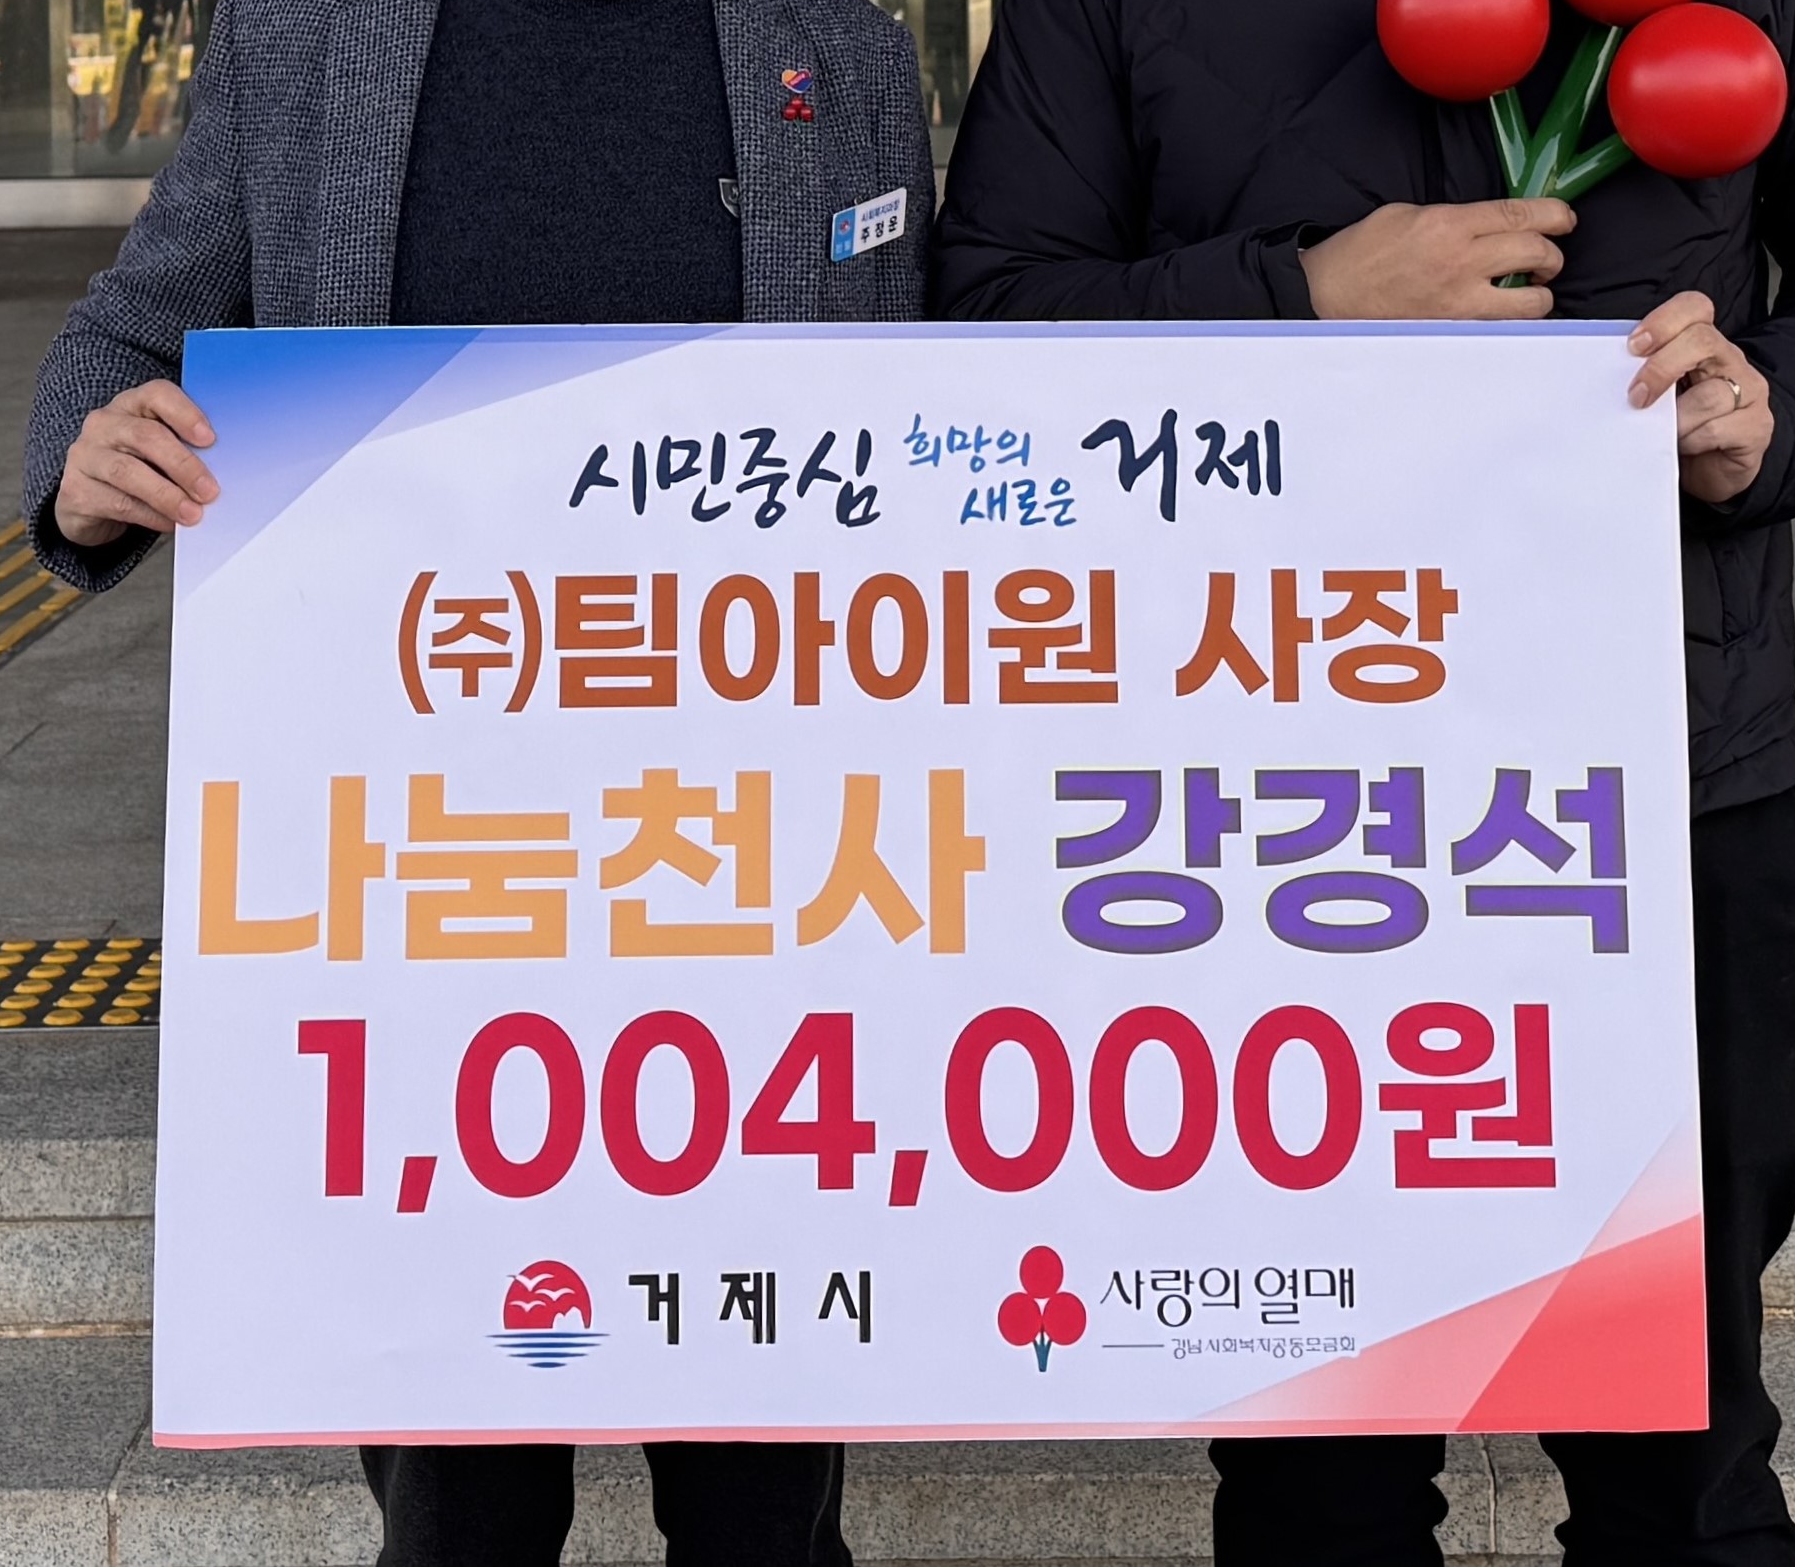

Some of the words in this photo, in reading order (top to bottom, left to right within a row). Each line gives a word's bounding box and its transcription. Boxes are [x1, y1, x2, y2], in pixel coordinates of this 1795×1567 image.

[568, 427, 882, 530] 시민중심
[902, 412, 1031, 474] 희망의
[1080, 407, 1282, 523] 거제
[959, 477, 1078, 528] 새로운
[397, 568, 1119, 715] (주)팀아이원
[1175, 567, 1459, 705] 사장
[198, 768, 987, 962] 나눔천사
[1054, 766, 1630, 956] 강경석
[297, 1001, 1557, 1214] 1,004,000원
[627, 1270, 873, 1346] 거제시
[1100, 1267, 1241, 1328] 사랑의
[1253, 1267, 1355, 1325] 열매
